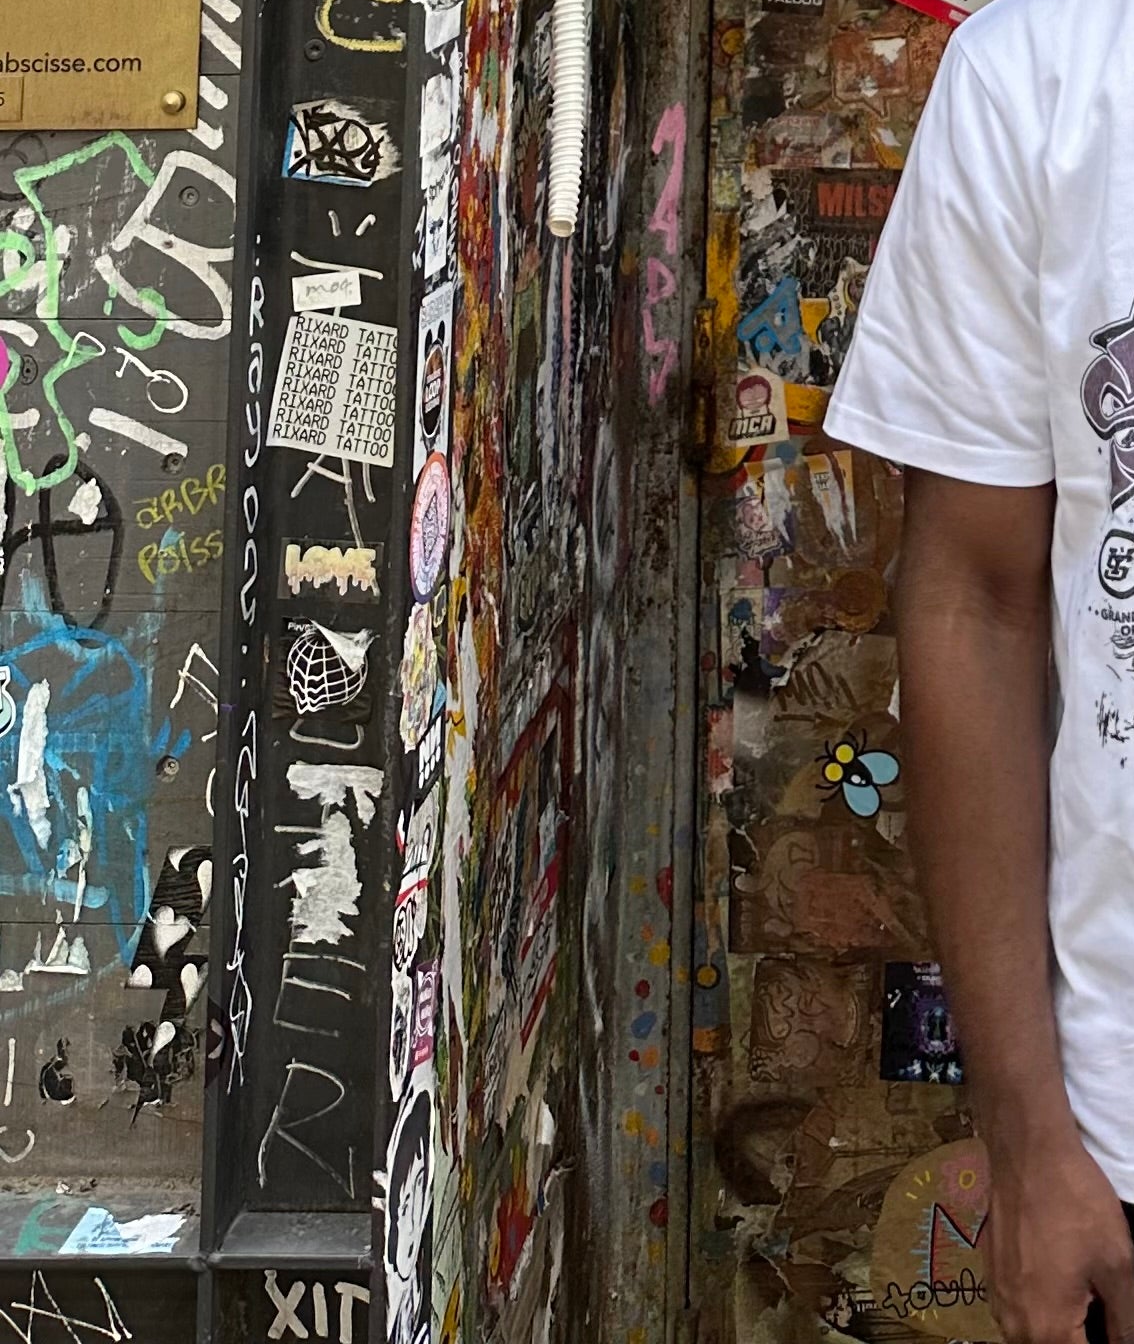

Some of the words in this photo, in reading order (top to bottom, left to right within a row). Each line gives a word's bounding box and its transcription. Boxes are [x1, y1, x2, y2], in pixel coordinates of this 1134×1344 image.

[296, 316, 348, 339] RIXARD
[293, 332, 345, 354] RIXARD
[289, 347, 342, 369] RIXARD
[286, 362, 339, 384] RIXARD
[282, 377, 336, 399] RIXARD
[279, 393, 333, 415] RIXARD
[343, 404, 395, 427] TATTOO
[276, 408, 329, 430] RIXARD
[340, 419, 392, 443] TATTOO
[733, 414, 775, 437] MCA
[273, 424, 326, 445] RIXARD
[336, 435, 388, 458] TATTOO
